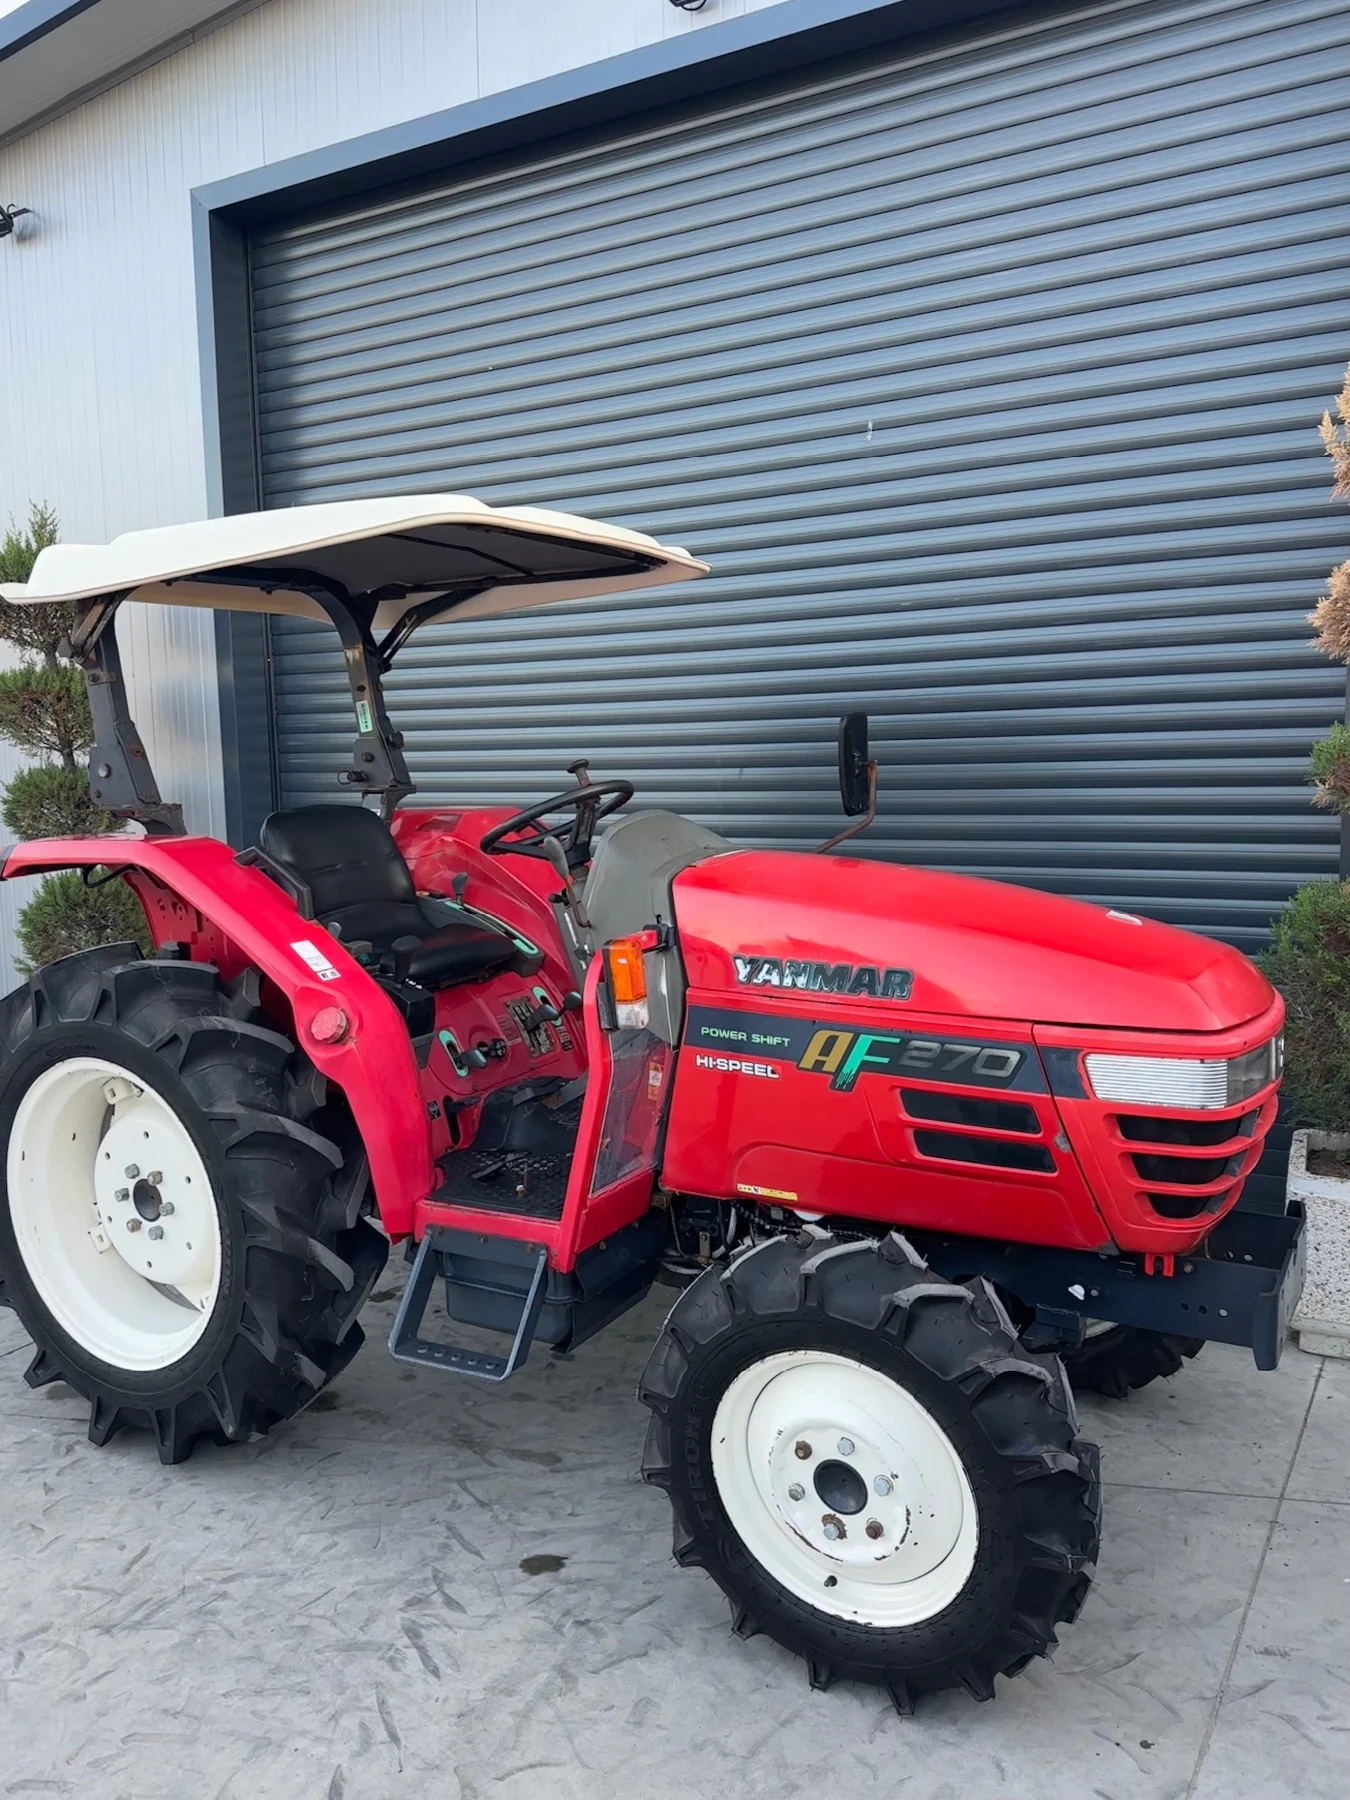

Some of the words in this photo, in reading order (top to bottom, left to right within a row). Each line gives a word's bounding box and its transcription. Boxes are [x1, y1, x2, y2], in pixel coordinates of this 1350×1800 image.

[733, 955, 914, 1000] YANMAR
[701, 1026, 748, 1042] POWER
[751, 1033, 791, 1048] SHIFT
[798, 1029, 901, 1090] AF
[899, 1040, 1022, 1079] 270
